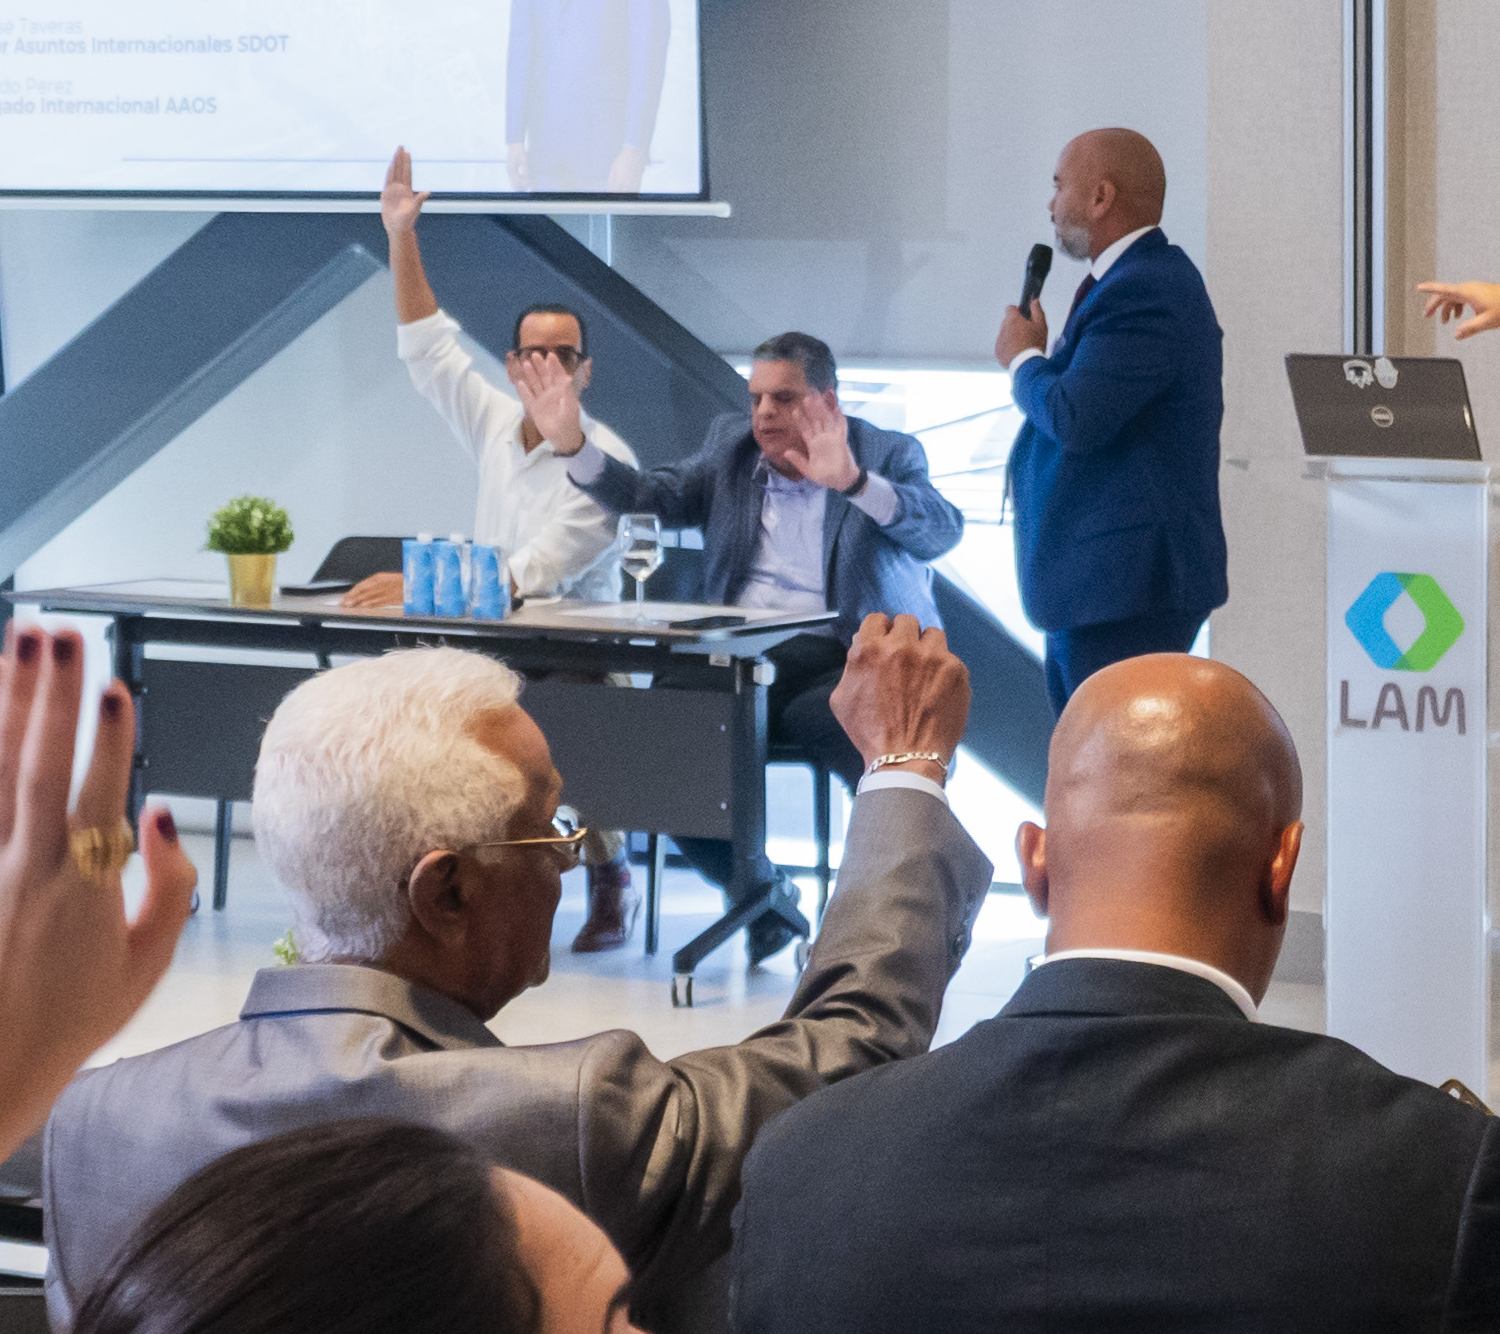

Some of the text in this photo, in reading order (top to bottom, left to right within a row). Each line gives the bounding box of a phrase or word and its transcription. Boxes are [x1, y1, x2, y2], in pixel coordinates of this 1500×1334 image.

[19, 18, 83, 35] Taveras
[13, 37, 87, 54] Asuntos
[91, 34, 233, 54] Internacionales
[237, 34, 290, 53] SDOT
[40, 96, 160, 114] Internacional
[164, 96, 218, 114] AAOS
[1340, 680, 1467, 736] LAM
